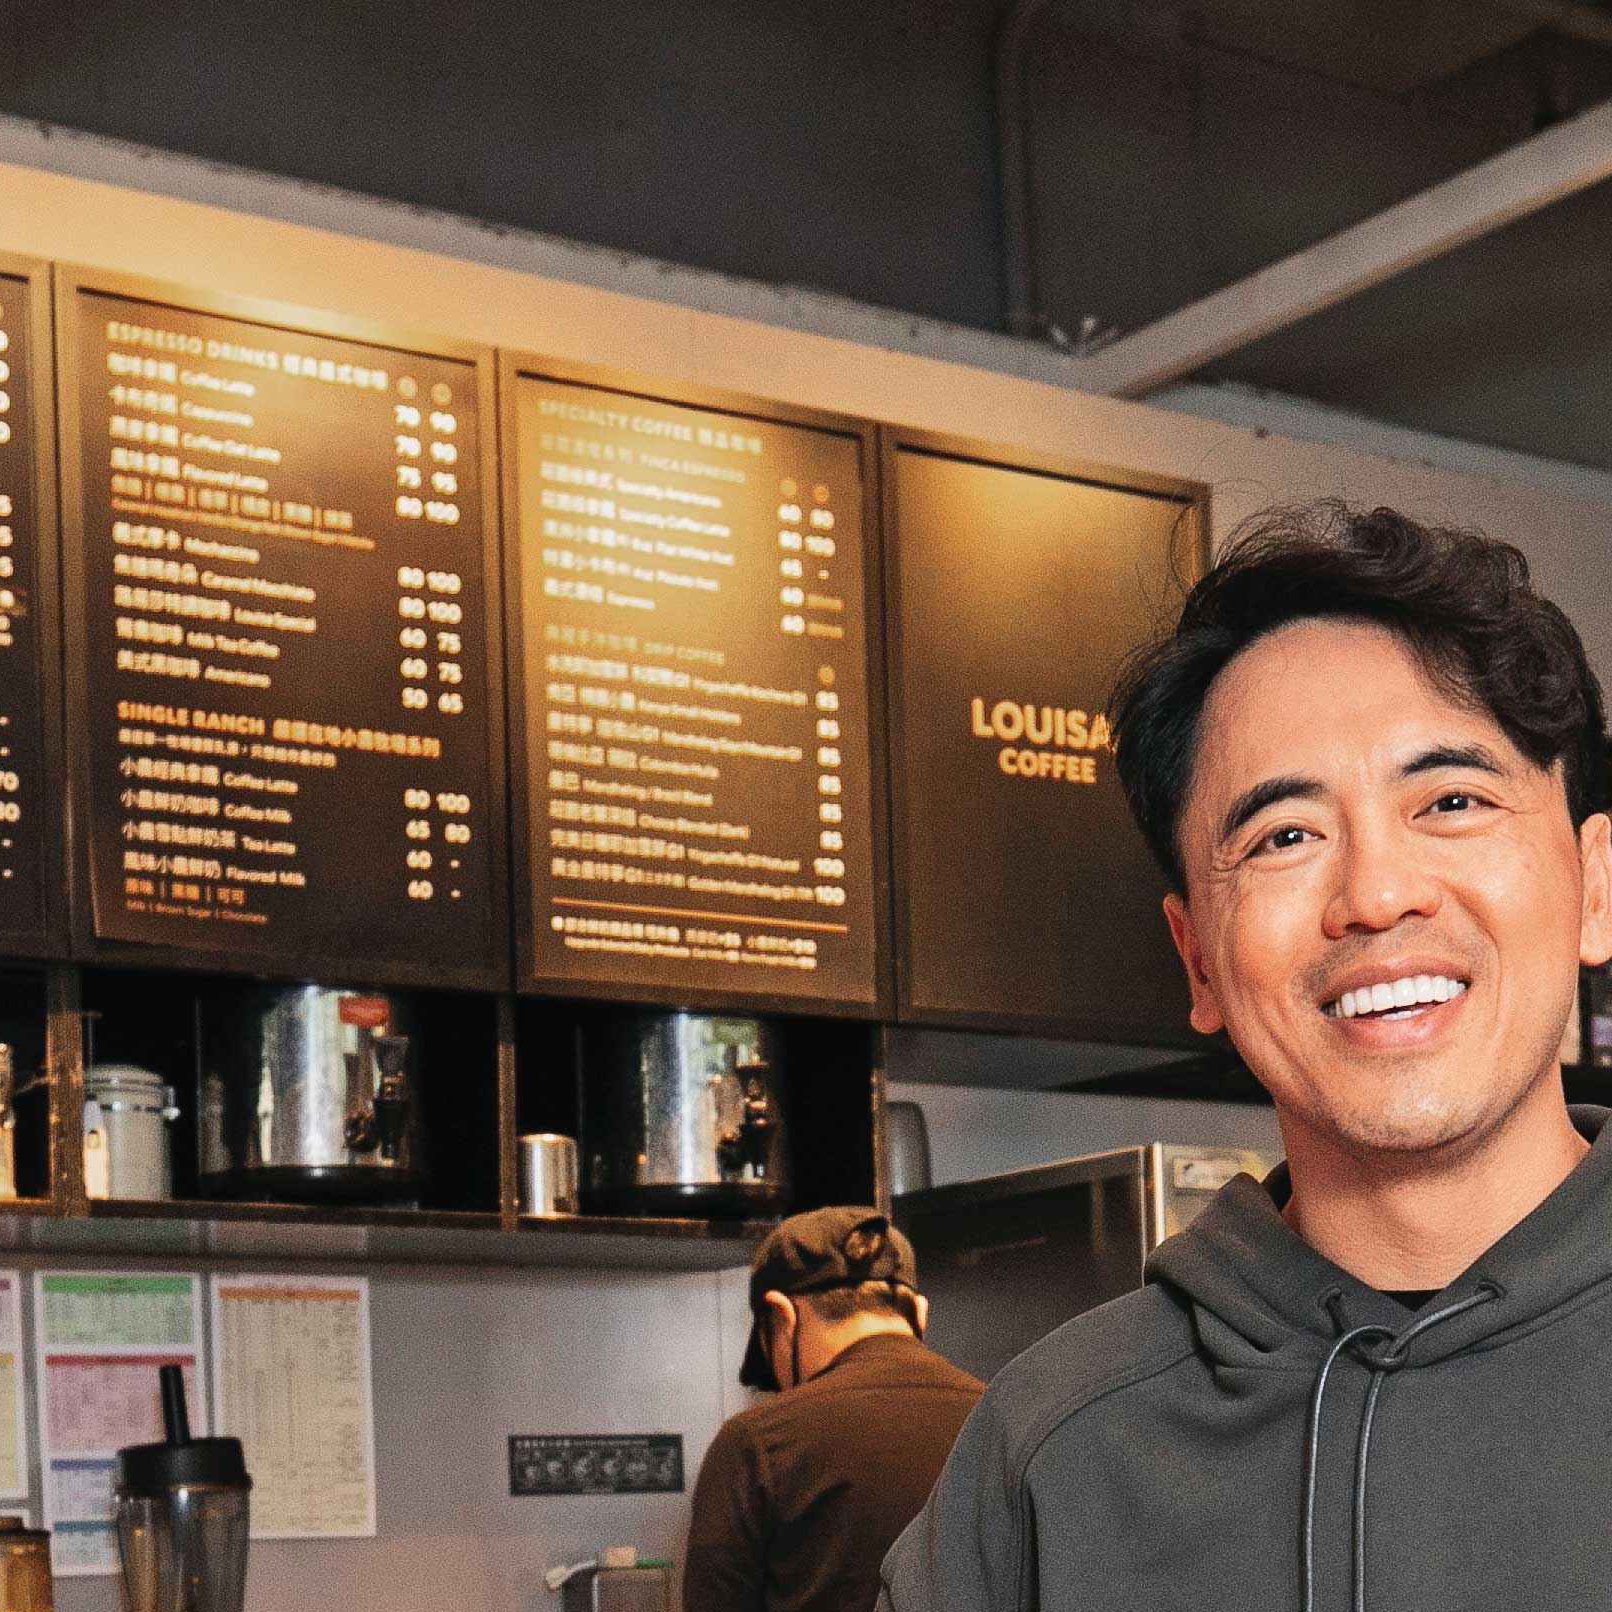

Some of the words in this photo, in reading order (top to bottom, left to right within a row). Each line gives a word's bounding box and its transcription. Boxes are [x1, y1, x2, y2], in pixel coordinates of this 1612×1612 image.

[206, 340, 281, 372] DRINKS
[118, 701, 189, 726] SINGLE
[971, 697, 1110, 750] LOUISA
[999, 748, 1096, 783] COFFEE
